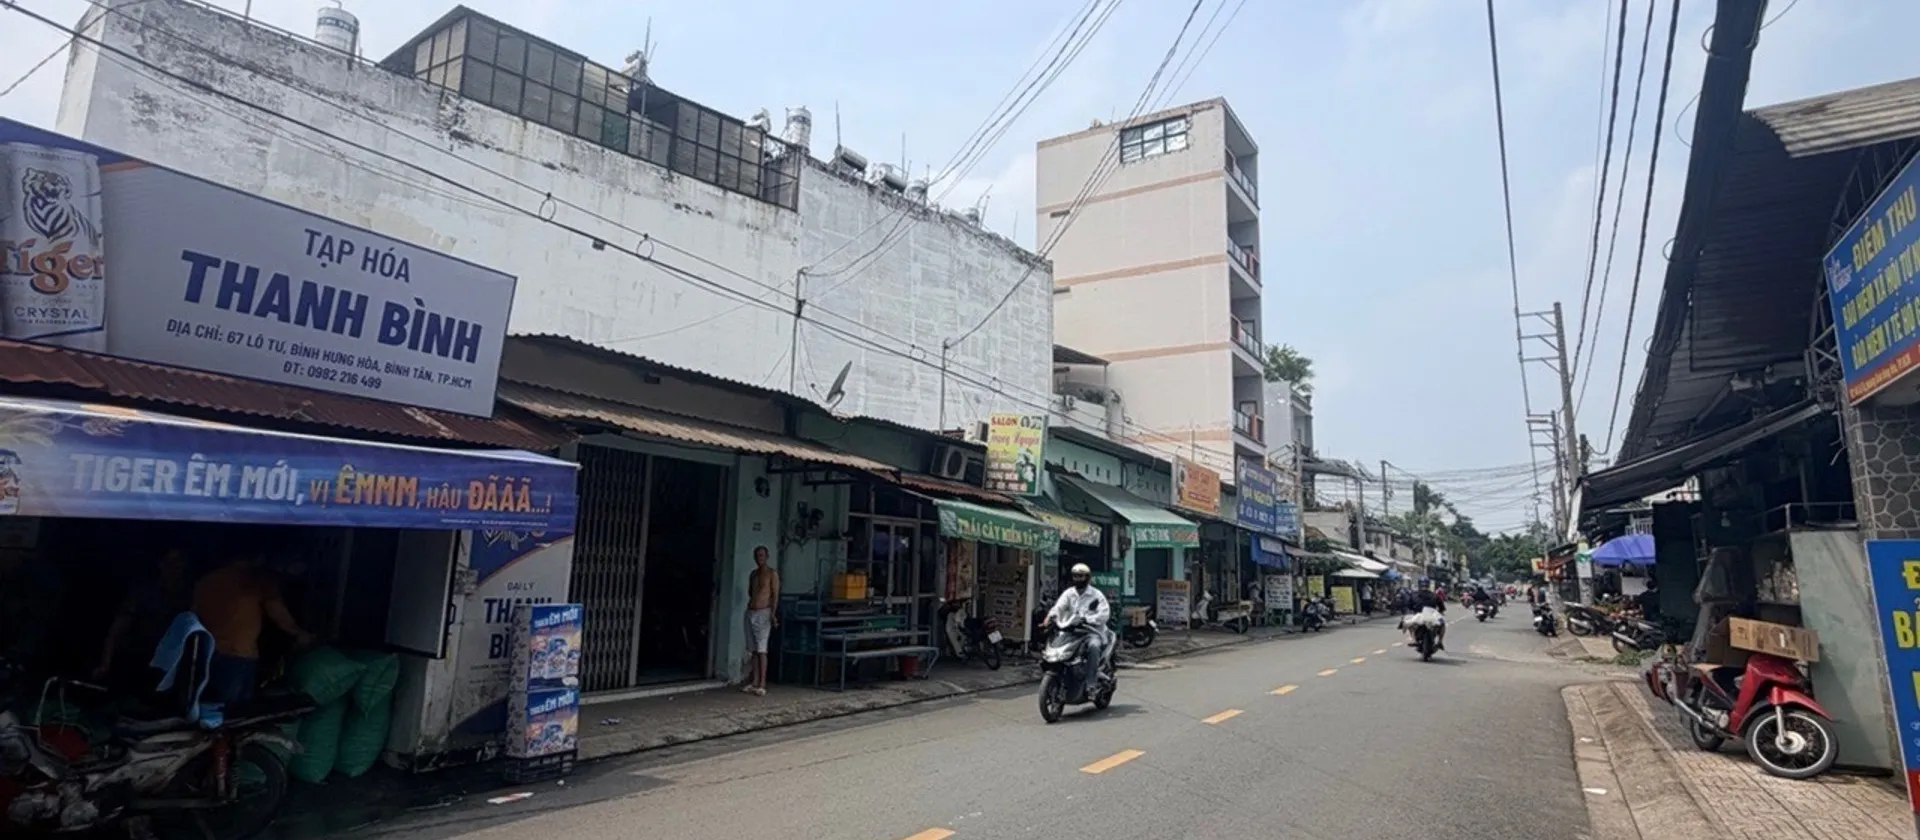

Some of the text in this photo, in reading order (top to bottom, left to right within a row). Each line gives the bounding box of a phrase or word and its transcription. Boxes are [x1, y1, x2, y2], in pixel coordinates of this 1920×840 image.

[305, 228, 410, 283] TẠP HÓA
[1852, 184, 1917, 273] ĐIỂM THU
[14, 306, 90, 320] CRYSTAL
[182, 250, 483, 364] THANH BÌNH
[166, 318, 191, 337] ĐỊA
[195, 324, 222, 342] CHỈ:
[227, 331, 245, 345] 67
[247, 333, 264, 349] LÔ
[290, 341, 320, 360] BÌNH
[384, 360, 410, 377] BÌNH
[438, 372, 473, 389] TP.HCM
[283, 361, 382, 390] ĐT: 0982 216 499
[991, 416, 1017, 426] SALON
[69, 453, 177, 495] TIGER
[184, 452, 231, 498] ÊM
[239, 459, 305, 506] MỚI,
[310, 479, 328, 508] VỊ
[335, 464, 421, 510] ÊMMM,
[426, 482, 461, 515] HẬU
[982, 520, 1000, 541] CÂY
